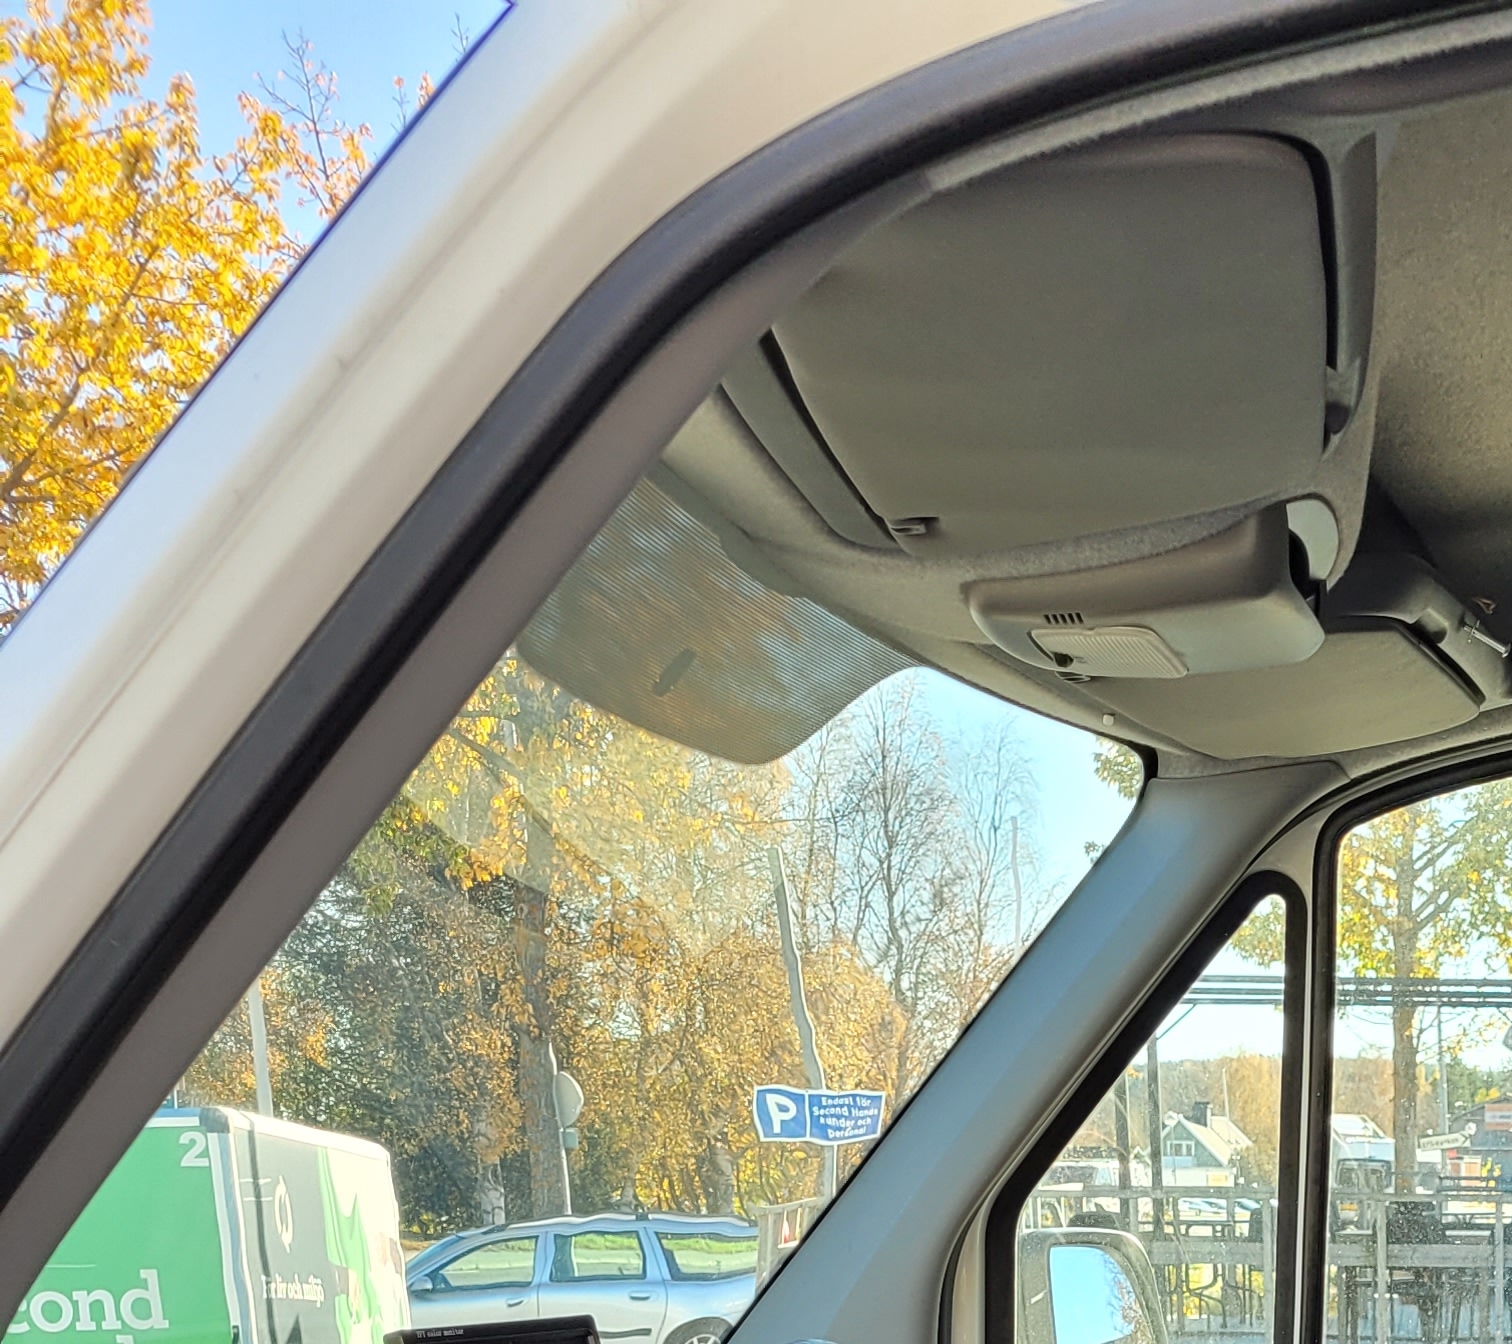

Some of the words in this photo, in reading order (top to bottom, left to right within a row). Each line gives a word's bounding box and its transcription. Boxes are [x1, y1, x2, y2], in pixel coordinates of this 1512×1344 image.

[821, 1096, 854, 1106] Endast
[856, 1096, 872, 1107] för
[812, 1105, 849, 1116] Second
[820, 1116, 855, 1127] kunder
[856, 1117, 872, 1125] och
